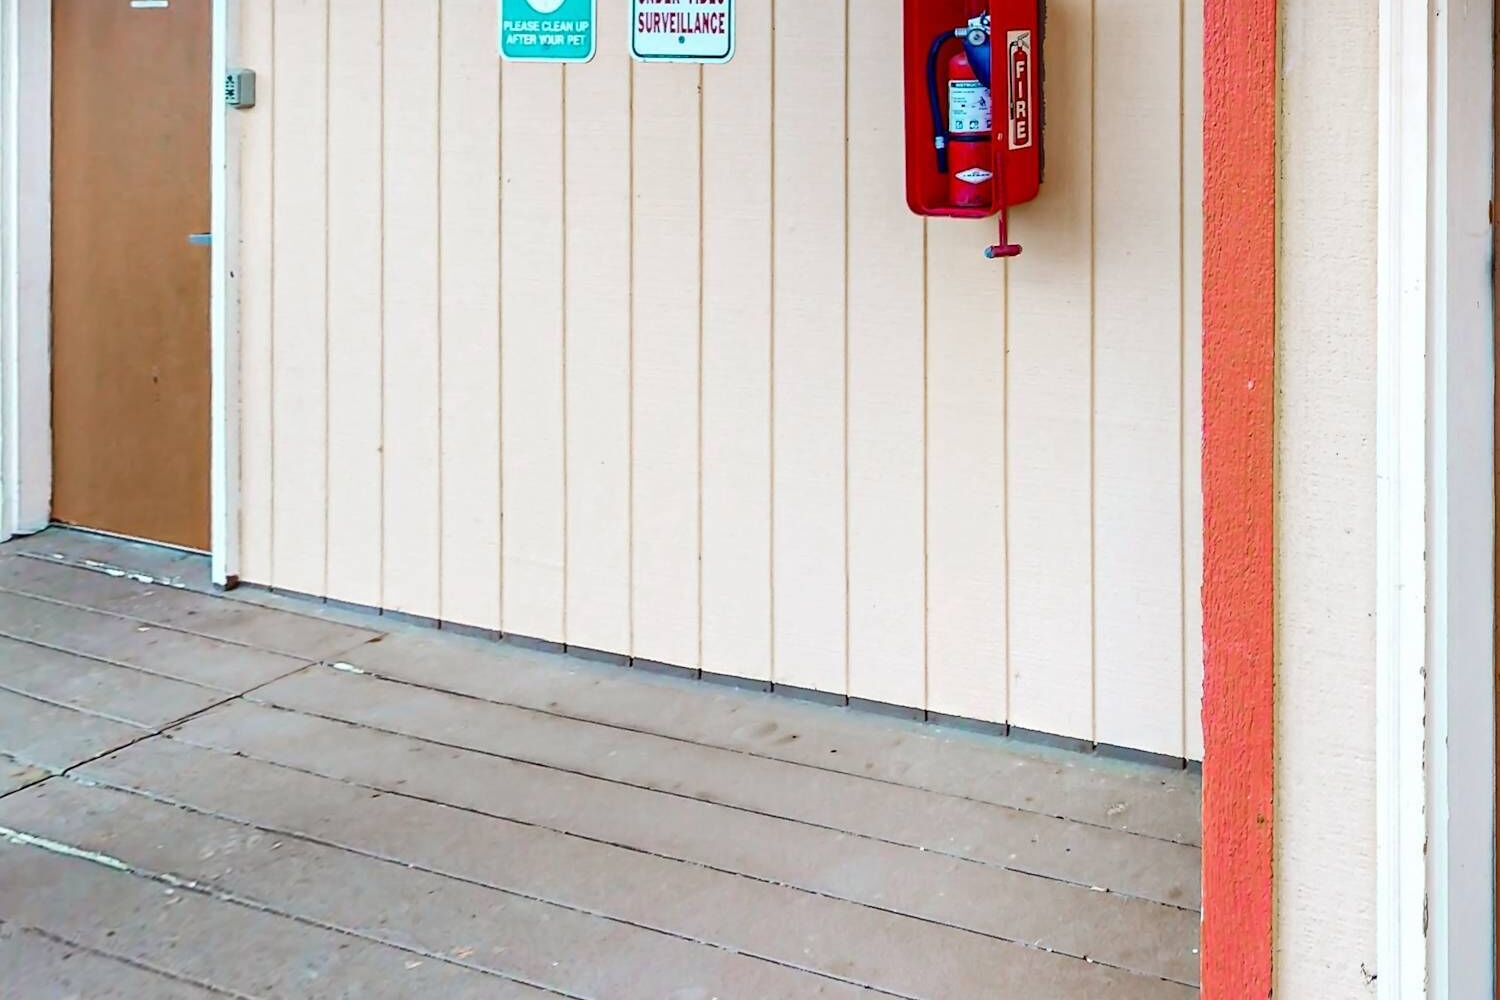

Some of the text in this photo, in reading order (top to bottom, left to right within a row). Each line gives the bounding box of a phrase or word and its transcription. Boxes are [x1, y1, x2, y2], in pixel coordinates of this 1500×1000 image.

[503, 19, 590, 32] PLEASE CLEAN UP
[637, 12, 726, 34] SURVEILLANCE
[505, 34, 586, 46] AFTER YOUR PET
[1016, 61, 1026, 139] FIRE
